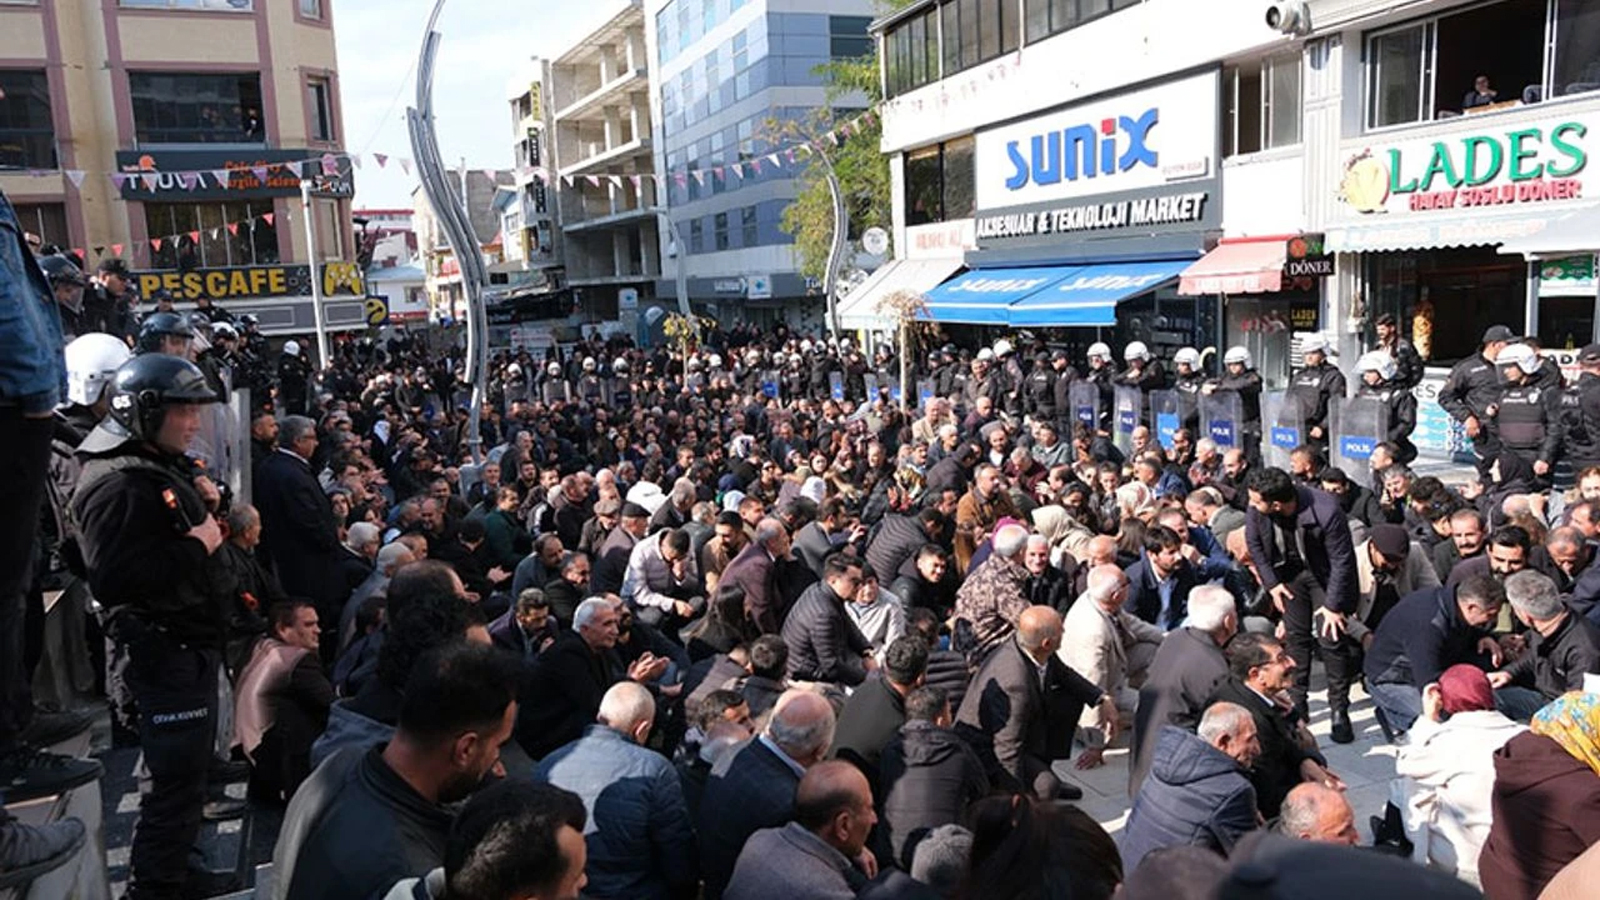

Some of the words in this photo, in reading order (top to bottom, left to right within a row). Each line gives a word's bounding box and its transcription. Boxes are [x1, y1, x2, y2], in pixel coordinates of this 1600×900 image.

[1386, 122, 1588, 194] LADES
[1038, 212, 1052, 232] &
[1130, 192, 1208, 225] MARKET
[1409, 191, 1458, 211] HATAY
